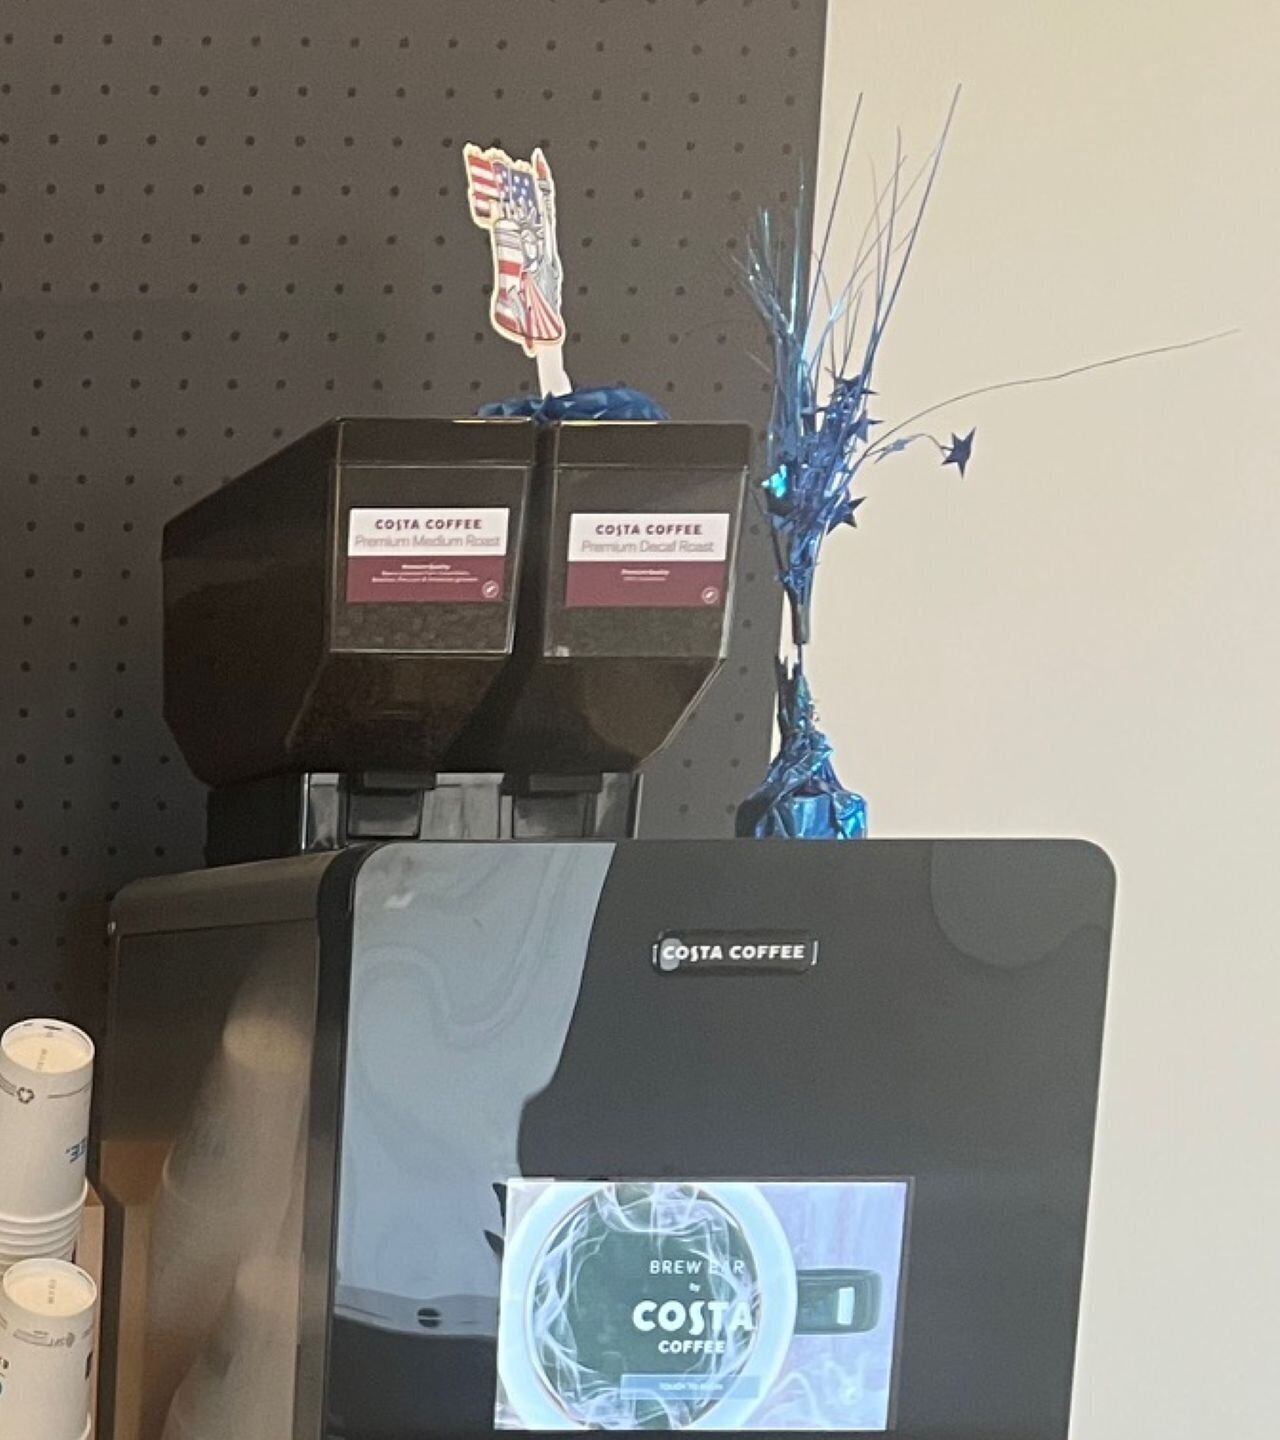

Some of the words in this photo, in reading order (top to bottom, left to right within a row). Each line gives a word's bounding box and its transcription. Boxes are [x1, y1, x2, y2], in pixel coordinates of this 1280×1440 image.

[375, 519, 420, 531] COSTA
[426, 519, 482, 530] COFFEE
[596, 524, 640, 536] COSTA
[646, 524, 702, 535] COFFEE
[355, 535, 409, 547] Premium
[413, 535, 463, 547] Medium
[466, 535, 500, 547] Roast
[582, 540, 636, 552] Premium
[640, 540, 676, 552] Decaf
[679, 541, 714, 552] Roast
[663, 945, 723, 962] COSTA
[728, 945, 805, 960] COFFEE
[650, 1260, 702, 1274] BREW
[709, 1260, 745, 1274] BR
[632, 1300, 753, 1335] COSTA
[658, 1340, 725, 1354] COFFEE
